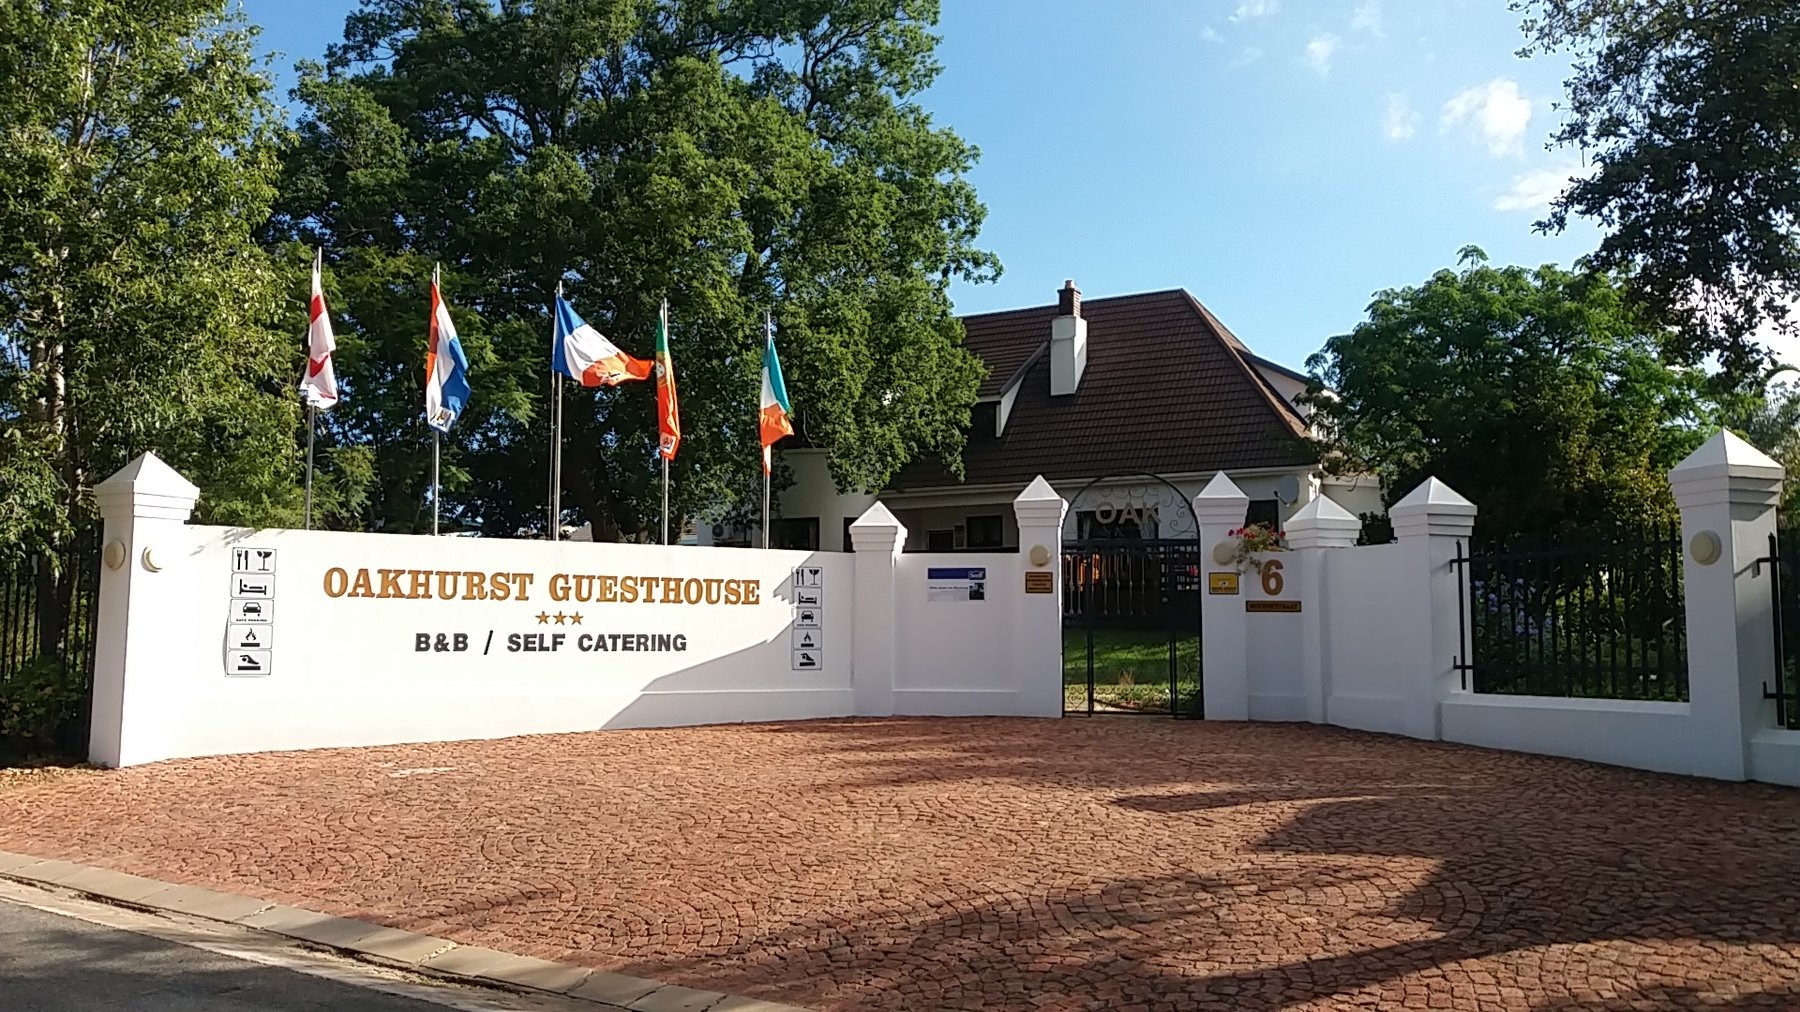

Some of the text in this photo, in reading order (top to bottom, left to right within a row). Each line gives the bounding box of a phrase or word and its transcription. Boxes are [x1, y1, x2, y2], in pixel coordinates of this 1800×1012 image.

[1095, 501, 1162, 525] OAK
[323, 566, 761, 606] OAKHURST GUESTHOUSE
[1262, 559, 1284, 596] 6
[415, 630, 687, 656] B&B / SELF CATERING
